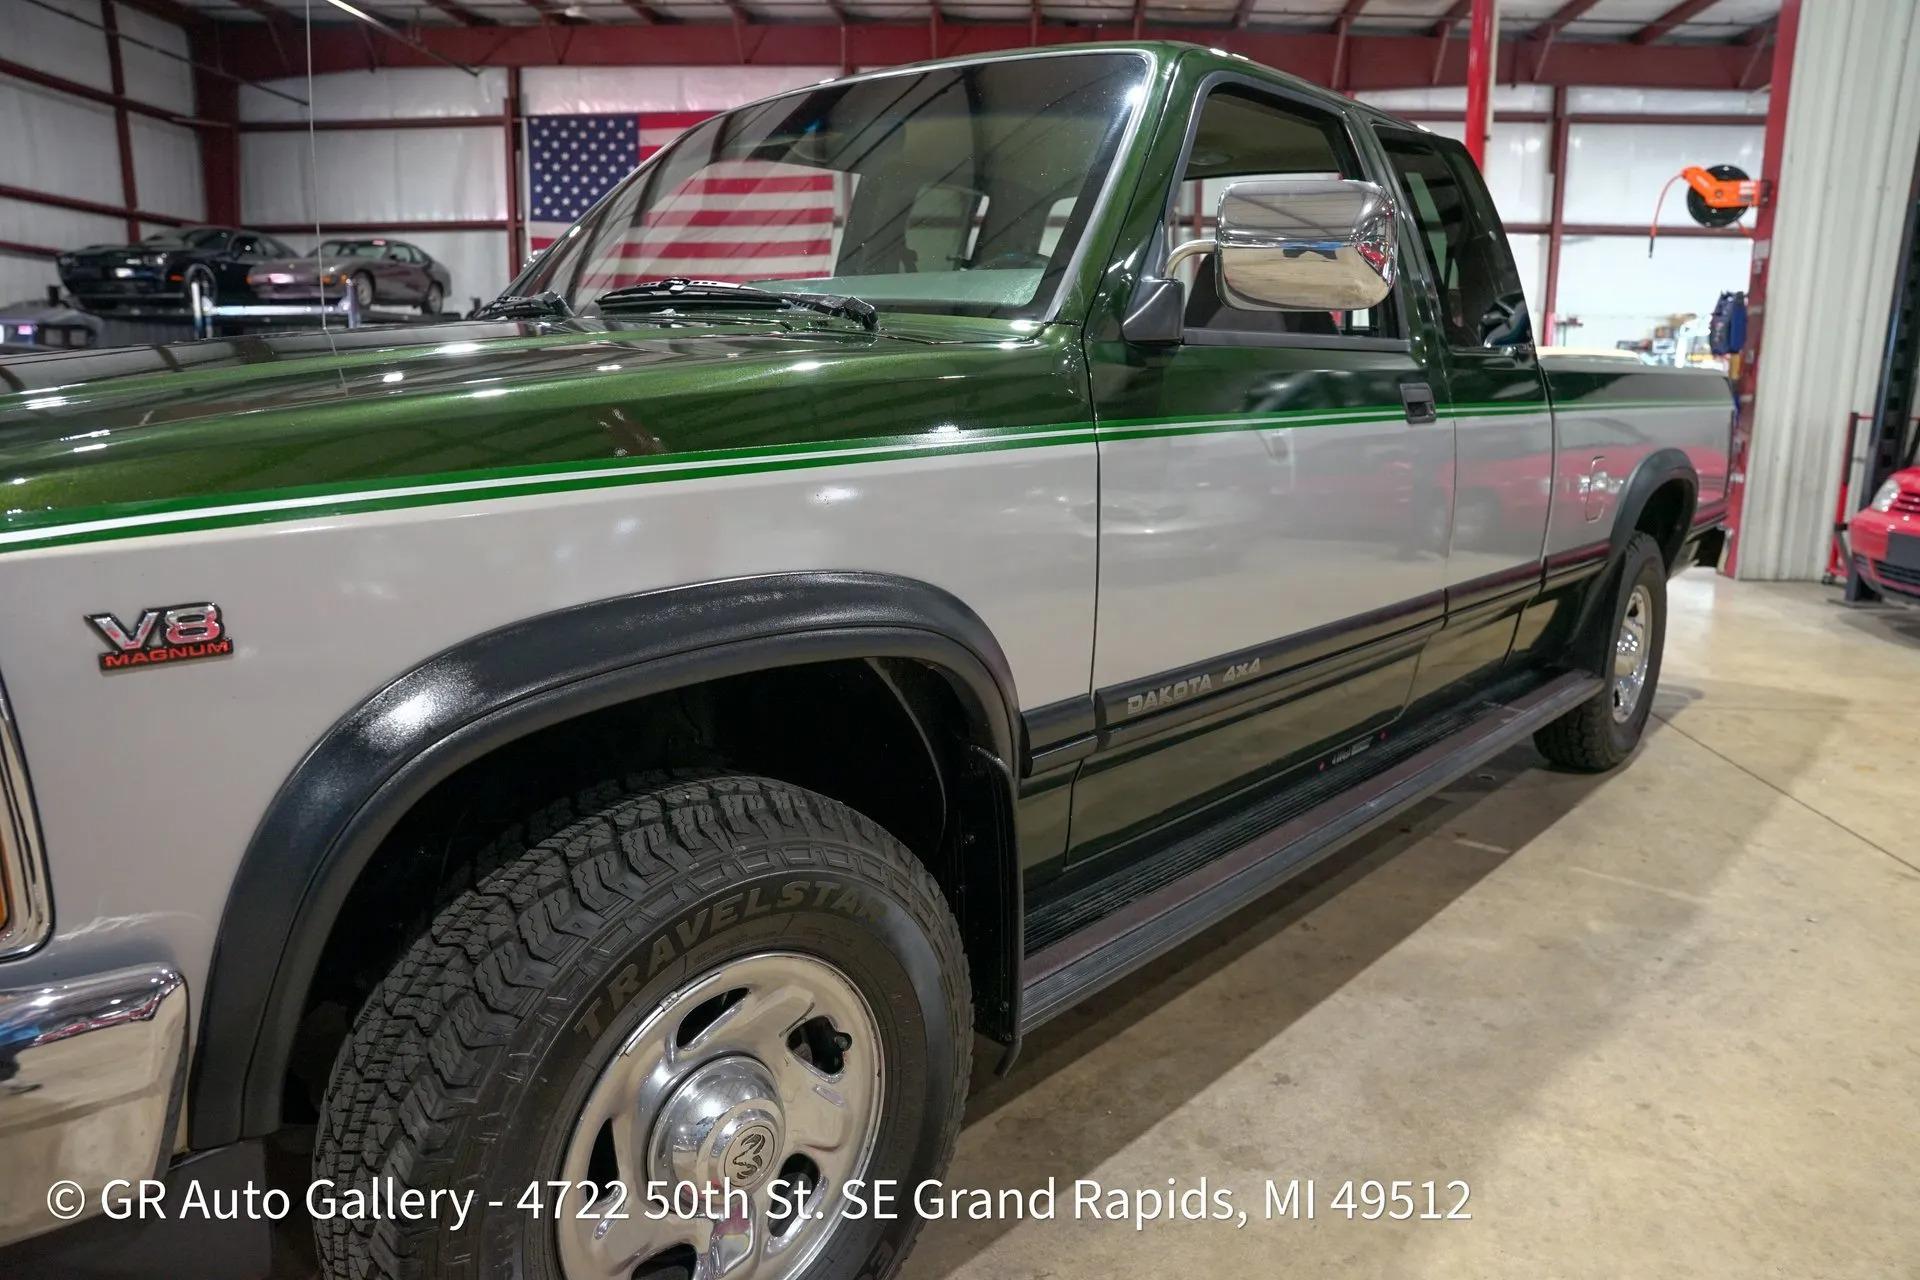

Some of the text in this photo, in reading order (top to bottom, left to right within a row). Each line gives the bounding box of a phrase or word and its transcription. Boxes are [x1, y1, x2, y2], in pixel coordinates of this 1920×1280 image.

[84, 601, 225, 650] V8
[104, 641, 231, 667] MAGNUM
[1127, 674, 1212, 715] DAKOTA
